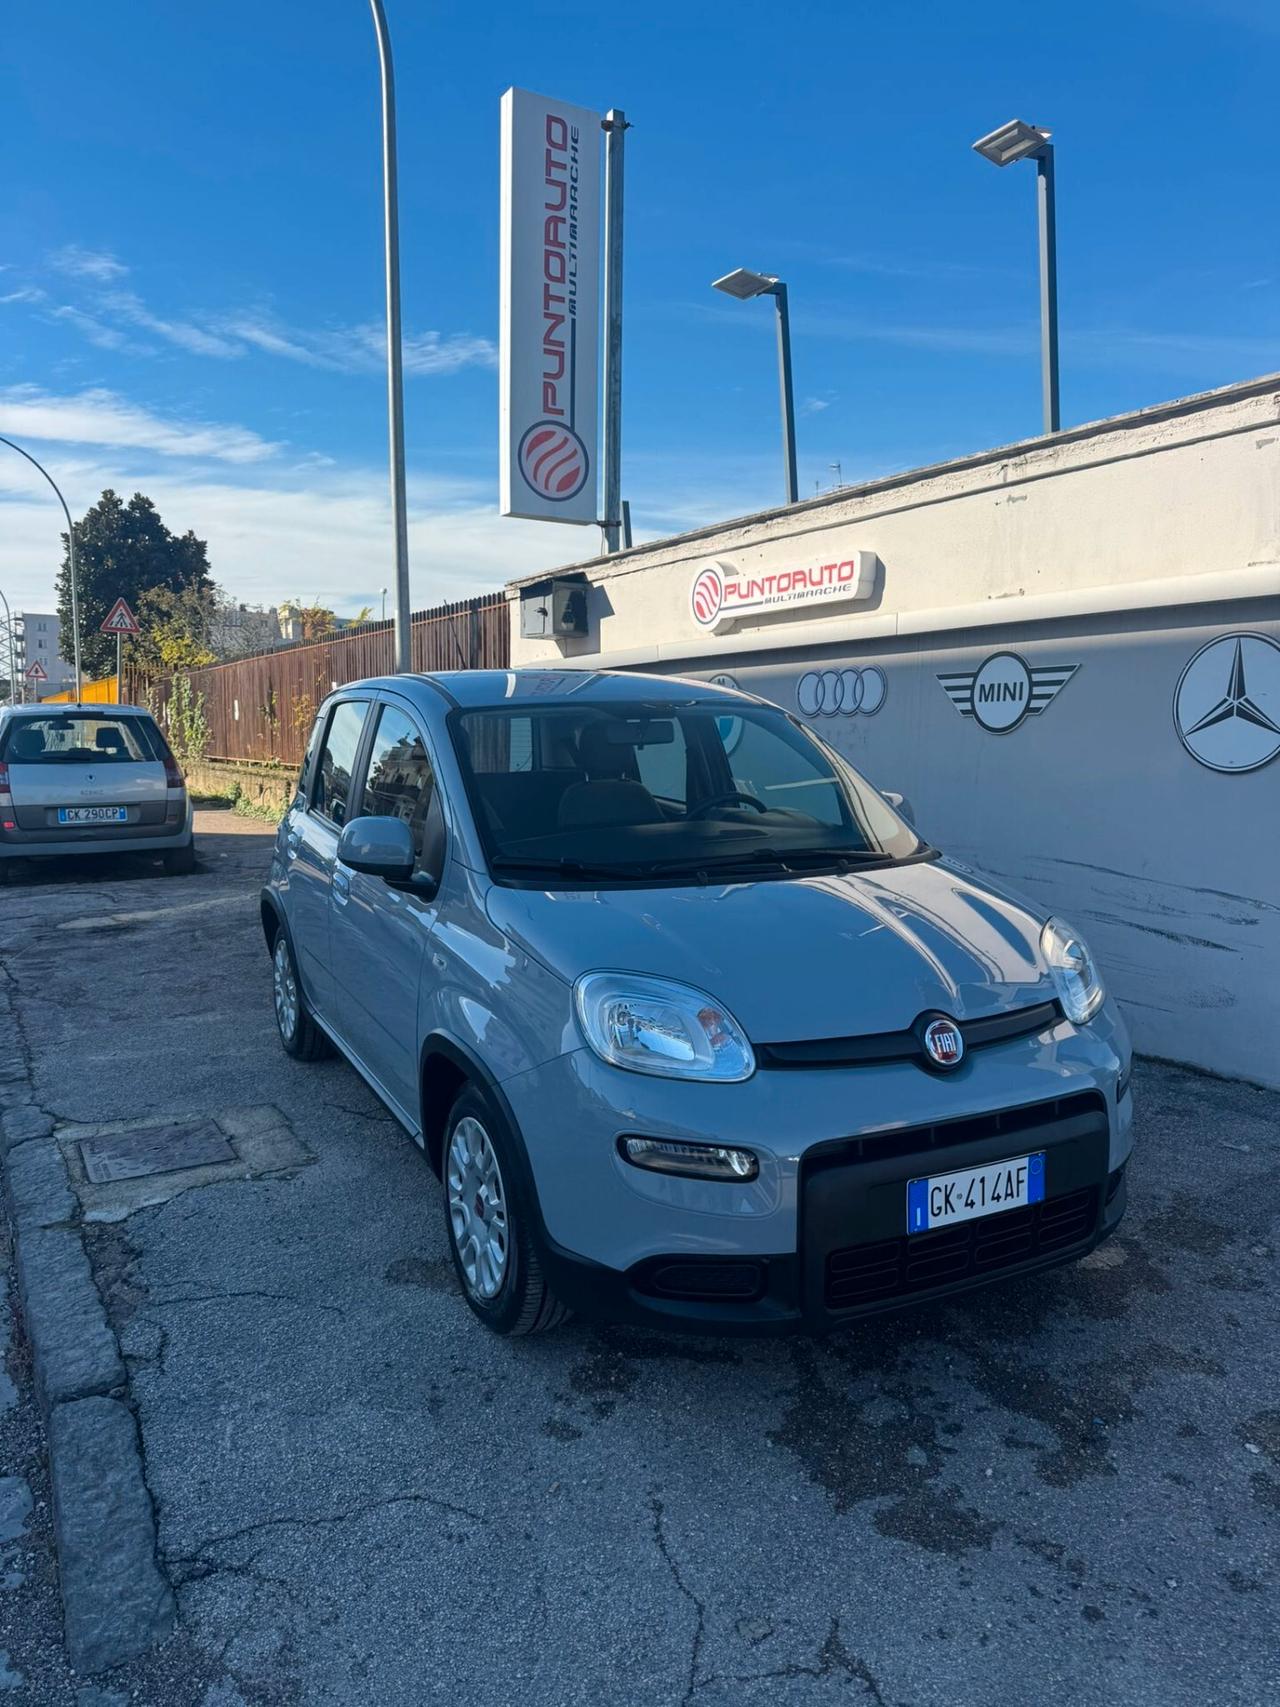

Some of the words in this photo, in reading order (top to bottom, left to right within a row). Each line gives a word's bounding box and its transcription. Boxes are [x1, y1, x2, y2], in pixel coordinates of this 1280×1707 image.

[568, 125, 580, 316] MULTIMARCHE
[543, 114, 568, 416] PUNTOAUTO
[724, 560, 854, 602] PUNTOAUTO
[764, 583, 852, 605] MULTIMARCHE
[978, 681, 1024, 703] MINI
[934, 1032, 957, 1053] FIAT
